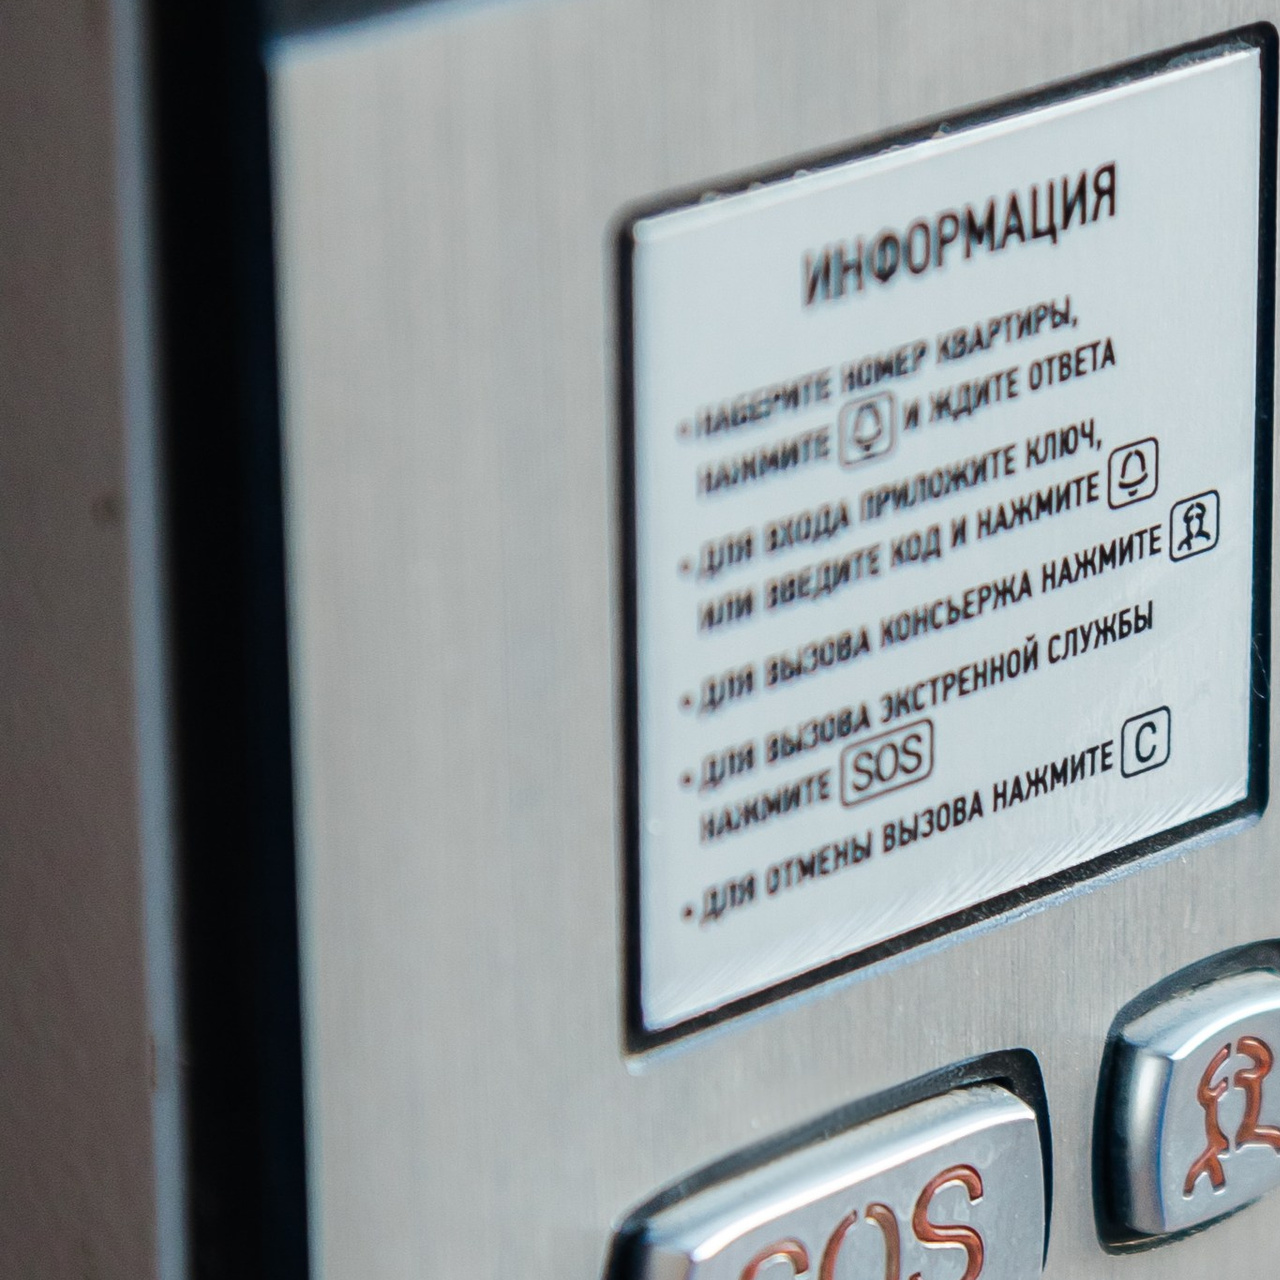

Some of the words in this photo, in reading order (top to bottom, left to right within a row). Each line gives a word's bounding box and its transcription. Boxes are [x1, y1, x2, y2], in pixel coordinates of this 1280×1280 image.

[803, 160, 1118, 307] ИНФОРМАЦИЯ
[698, 426, 831, 497] НАЖМИТЕ
[903, 396, 920, 430] И
[929, 367, 1018, 422] ЖДИТЕ
[1029, 336, 1116, 391] ОТВЕТА
[842, 338, 929, 394] НОМЕР
[936, 295, 1078, 364] КВАРТИРЫ,
[698, 528, 754, 579] ДЛЯ
[764, 500, 849, 554] ВХОДА
[861, 444, 1016, 521] ПРИЛОЖИТЕ
[1026, 417, 1101, 469] КЛЮЧ,
[698, 588, 754, 631] ИЛИ
[765, 543, 880, 610] ВВЕДИТЕ
[890, 523, 941, 567] КОД
[951, 516, 967, 549] И
[977, 471, 1099, 539] НАЖМИТЕ
[699, 663, 755, 715] ДЛЯ
[765, 626, 870, 686] ВЫЗОВА
[880, 569, 1033, 649] КОНСЬЕРЖА
[1042, 523, 1162, 593] НАЖМИТЕ
[700, 740, 755, 792] ДЛЯ
[766, 702, 870, 764] ВЫЗОВА
[881, 633, 1039, 723] ЭКСТРЕННОЙ
[1048, 599, 1153, 664] СЛУЖБЫ
[700, 875, 756, 924] ДЛЯ
[766, 830, 872, 895] ОТМЕНЫ
[883, 790, 984, 853] ВЫЗОВА
[993, 738, 1114, 813] НАЖМИТЕ
[701, 770, 830, 842] НАЖМИТЕ
[852, 733, 923, 792] SOS
